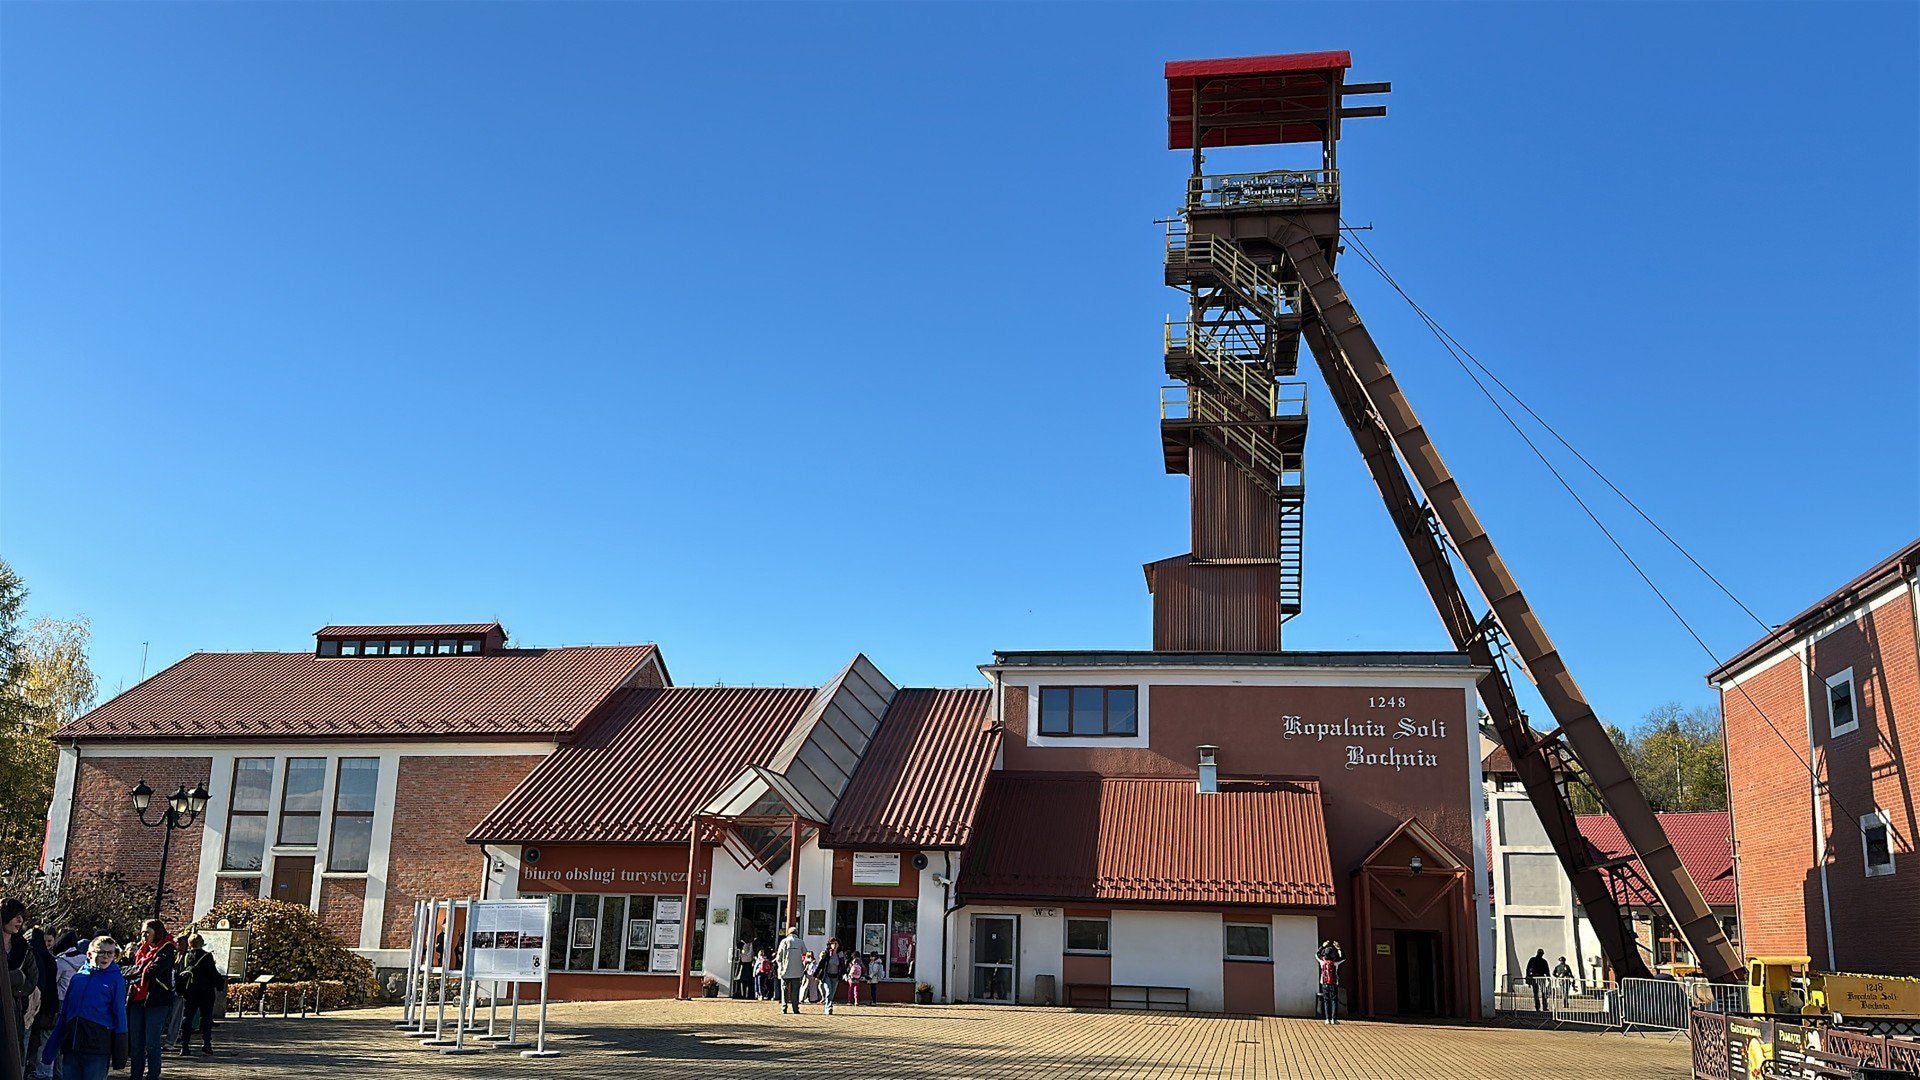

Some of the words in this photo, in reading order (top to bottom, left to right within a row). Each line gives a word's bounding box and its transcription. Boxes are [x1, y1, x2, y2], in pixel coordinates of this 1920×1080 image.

[1369, 697, 1406, 708] 1248
[1282, 715, 1386, 741] Kopalnia
[1393, 717, 1447, 740] Soli
[1345, 745, 1438, 771] Bochnia
[524, 866, 562, 880] biuro
[565, 867, 615, 884] obsługi
[621, 869, 707, 885] turystyczej
[1866, 983, 1884, 992] 1248
